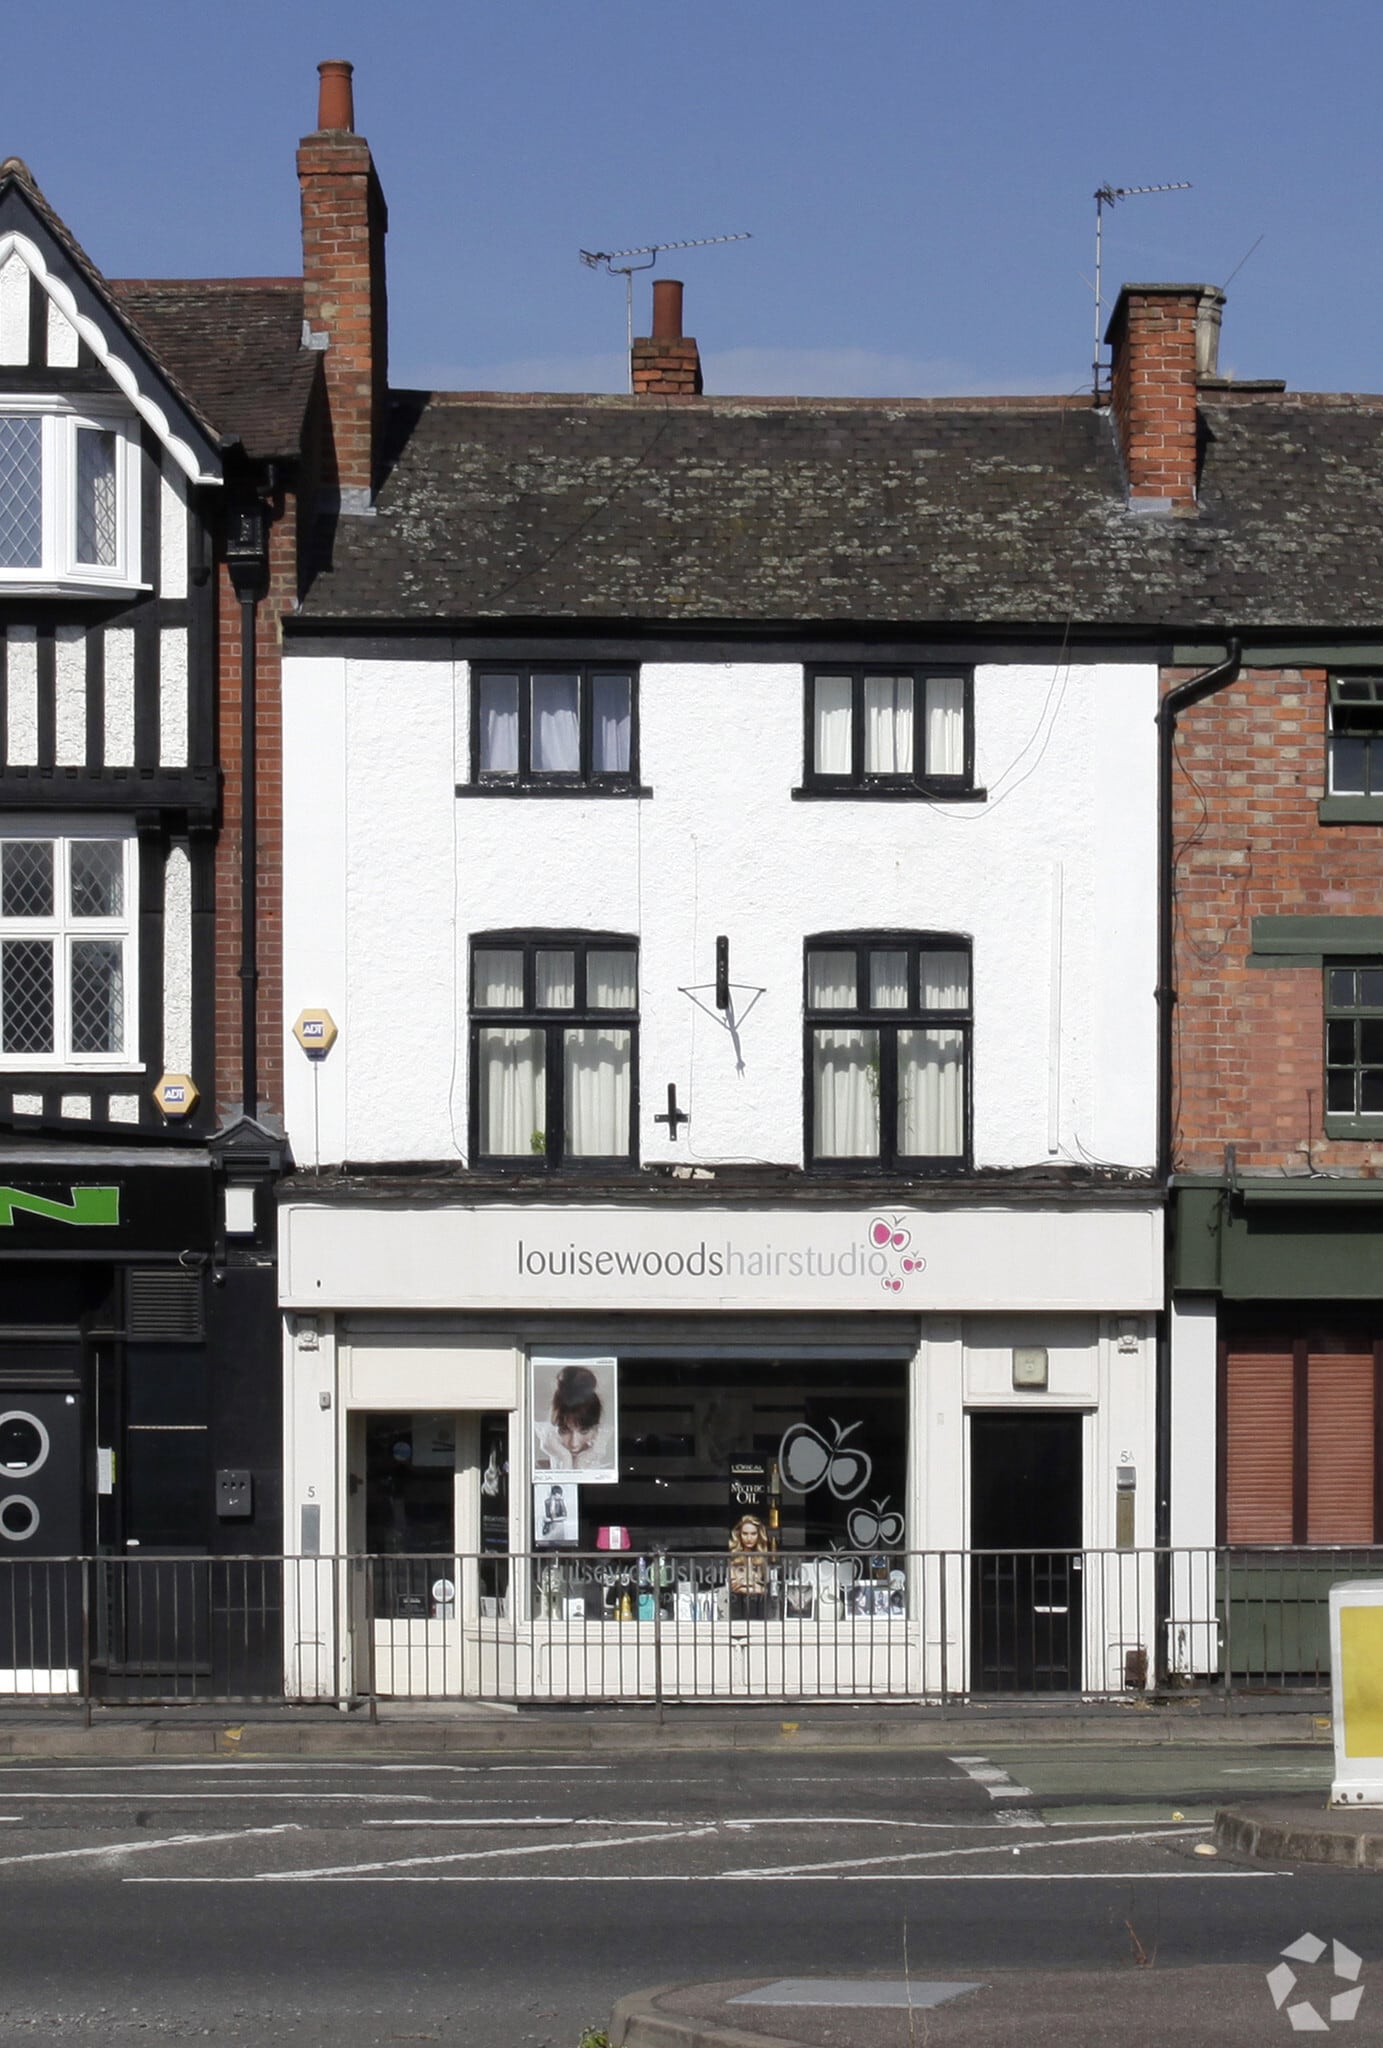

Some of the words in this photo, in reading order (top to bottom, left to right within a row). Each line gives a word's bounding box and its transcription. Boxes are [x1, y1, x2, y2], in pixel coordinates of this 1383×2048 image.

[303, 1023, 324, 1035] ADT
[164, 1088, 185, 1100] ADT
[307, 1485, 316, 1499] 5
[736, 1489, 760, 1505] OIL
